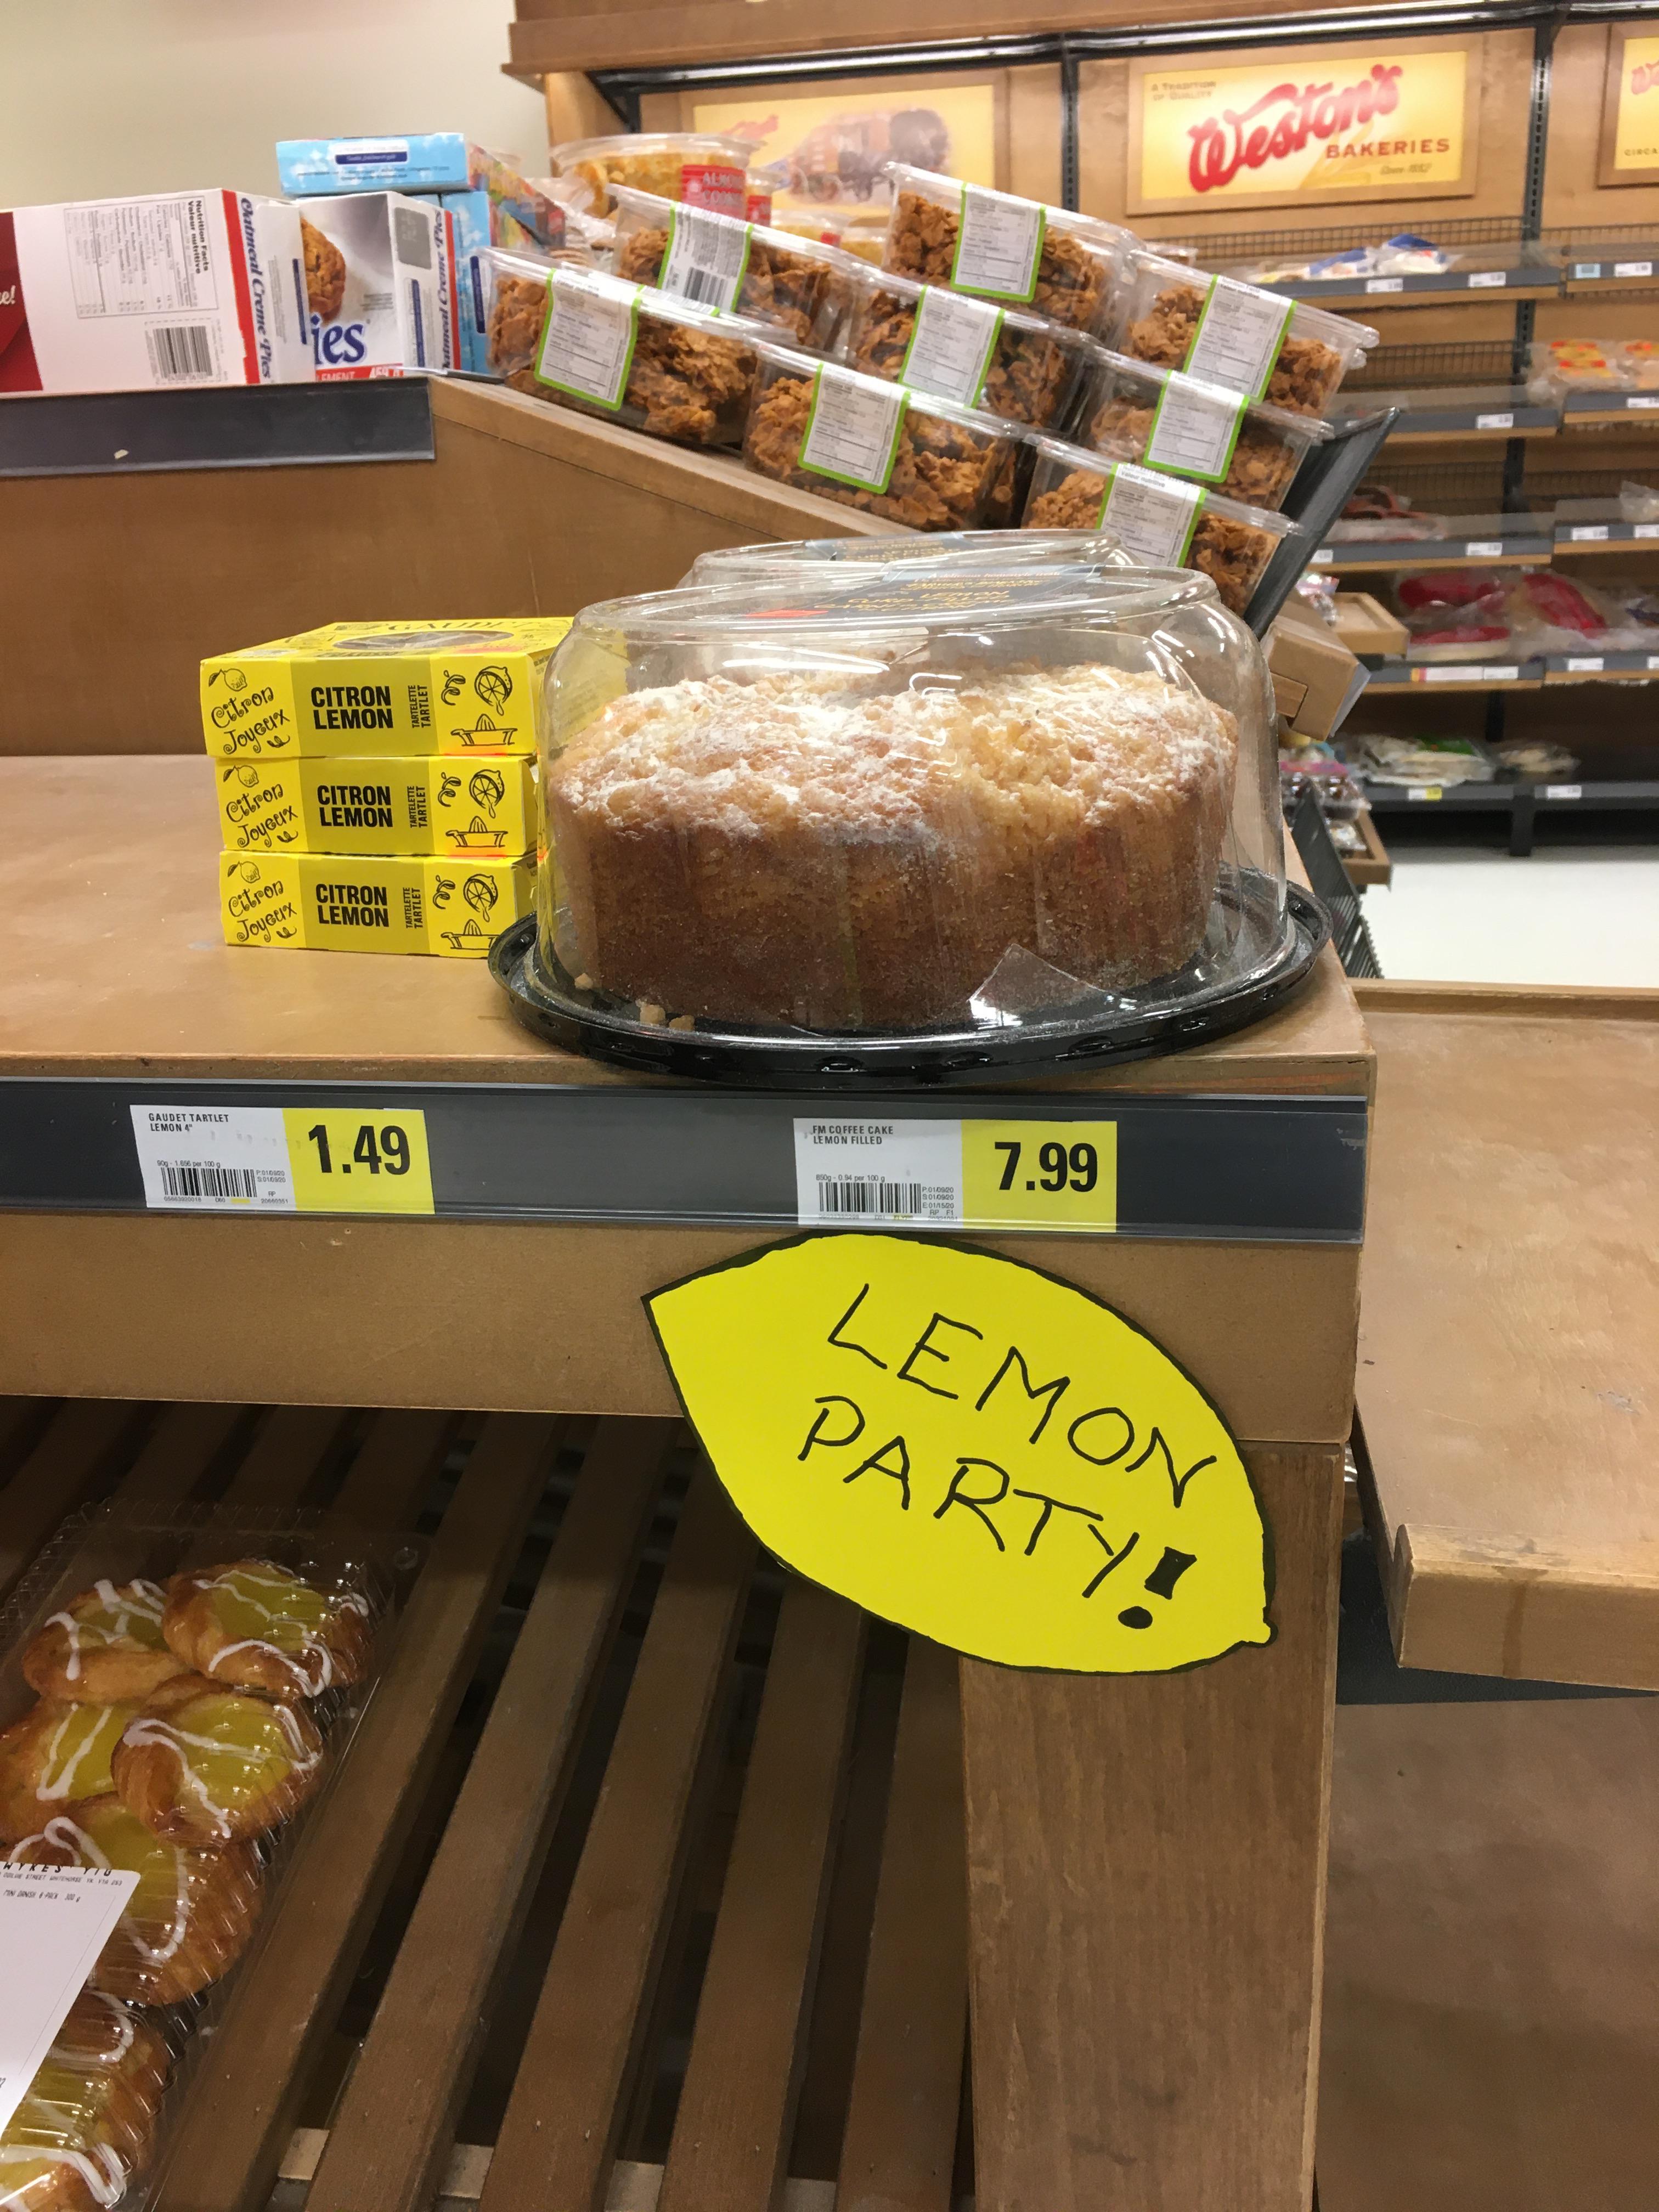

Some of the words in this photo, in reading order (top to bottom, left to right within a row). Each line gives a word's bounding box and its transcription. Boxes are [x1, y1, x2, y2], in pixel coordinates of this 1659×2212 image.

[1188, 64, 1403, 193] Weston's
[1326, 138, 1450, 159] BAKERIES
[196, 200, 205, 243] Nutrition
[192, 233, 201, 274] nutritive
[241, 198, 263, 275] Oatmeal
[252, 278, 266, 335] Creme
[259, 338, 272, 379] Pies
[311, 313, 365, 365] ies
[211, 685, 275, 729] Citron
[311, 685, 392, 708] CITRON
[408, 684, 418, 729] TARTELETTE
[421, 684, 432, 729] TARTLET
[223, 708, 291, 755] Joyeux
[313, 708, 394, 730] LEMON
[226, 783, 284, 823] Citron
[317, 785, 392, 806] CITRON
[407, 785, 415, 828] TARTELETTE
[418, 785, 427, 828] TARTLET
[237, 805, 299, 848] Joyeux
[319, 806, 393, 828] LEMON
[228, 879, 284, 918] Citron
[315, 883, 388, 906] CITRON
[403, 887, 411, 929] TARTELETTE
[413, 887, 423, 929] TARTLET
[236, 901, 297, 943] Joyeux
[317, 905, 390, 928] LEMON
[149, 1113, 187, 1122] GAUDET
[190, 1114, 229, 1123] TARTLET
[150, 1123, 183, 1132] LEMON
[184, 1124, 193, 1132] 4"
[812, 1125, 827, 1135] FM
[829, 1126, 865, 1135] COFFEE
[868, 1126, 894, 1135] CAKE
[308, 1124, 411, 1176] 1.49
[813, 1135, 848, 1144] LEMON
[850, 1136, 882, 1144] FILLED
[994, 1142, 1098, 1193] 7.99
[827, 1283, 1217, 1509] LEMON
[798, 1395, 1197, 1629] PARTY!
